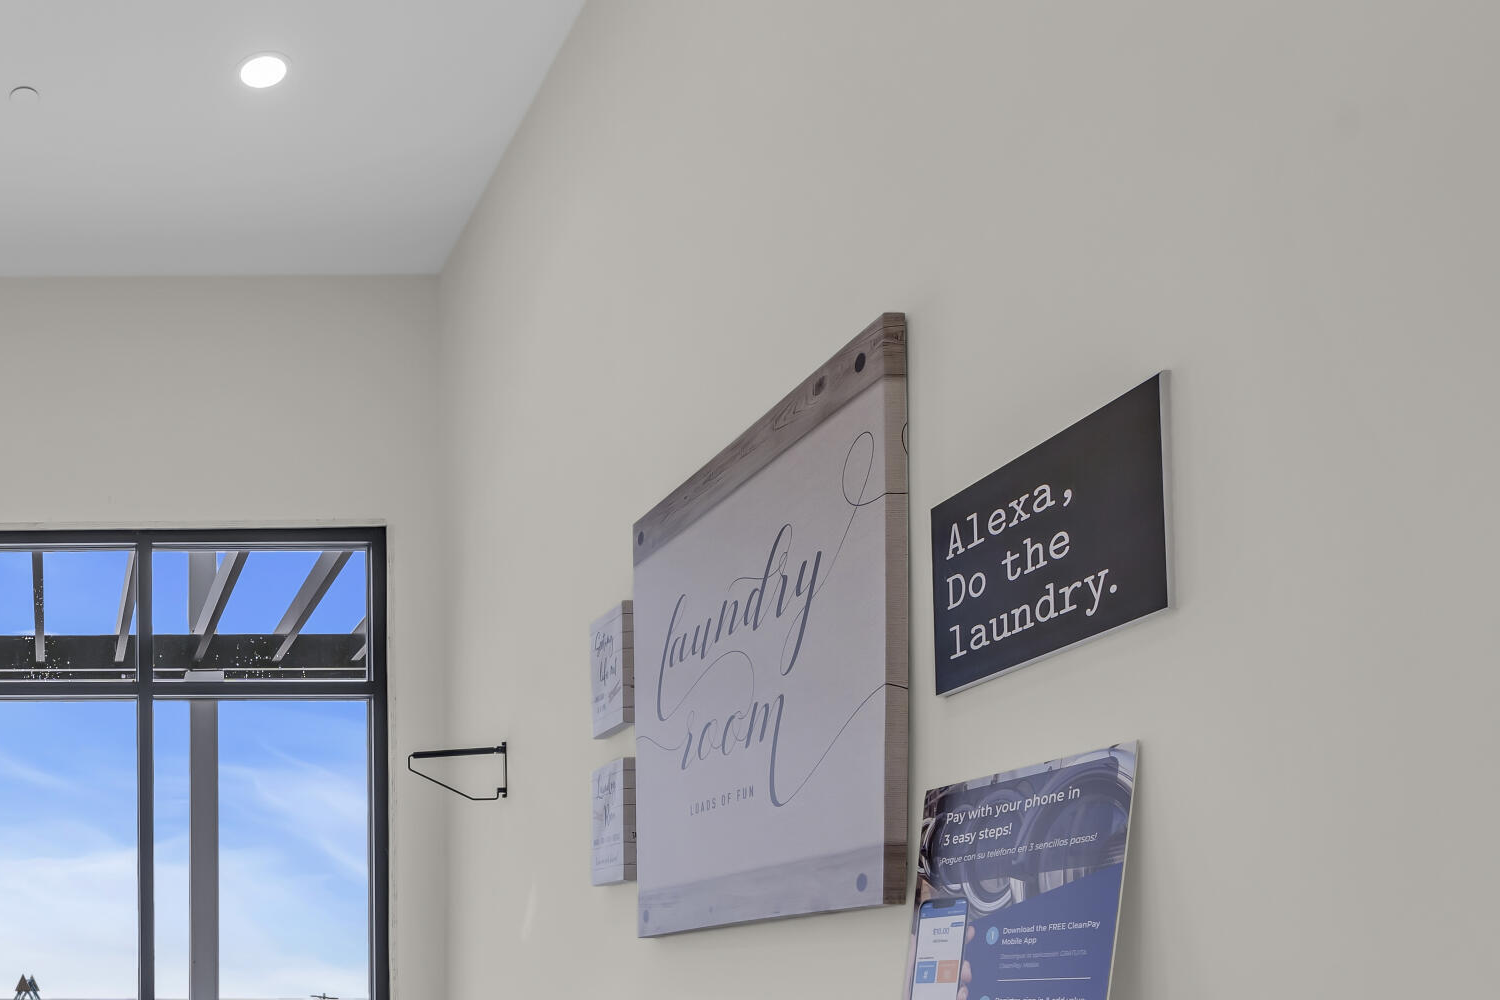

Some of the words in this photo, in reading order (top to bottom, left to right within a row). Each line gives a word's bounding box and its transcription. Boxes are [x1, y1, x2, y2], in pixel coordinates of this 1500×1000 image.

[945, 479, 1074, 560] Alexa,
[945, 571, 987, 611] Do
[1001, 529, 1072, 582] the
[948, 566, 1119, 660] laundry.
[690, 797, 717, 816] LOADS
[721, 792, 732, 806] OF
[736, 784, 754, 801] FUN
[946, 811, 966, 825] Pay
[968, 804, 992, 819] with
[994, 801, 1023, 818] your
[1024, 791, 1064, 811] phone
[1068, 786, 1081, 800] in
[943, 834, 951, 846] 3
[952, 832, 977, 845] easy
[979, 822, 1013, 840] steps!
[1001, 937, 1022, 945] Mobile
[1023, 937, 1037, 946] App
[1002, 924, 1034, 935] Download
[1035, 923, 1047, 933] the
[1048, 922, 1066, 931] FREE
[1067, 920, 1100, 930] CleanPay
